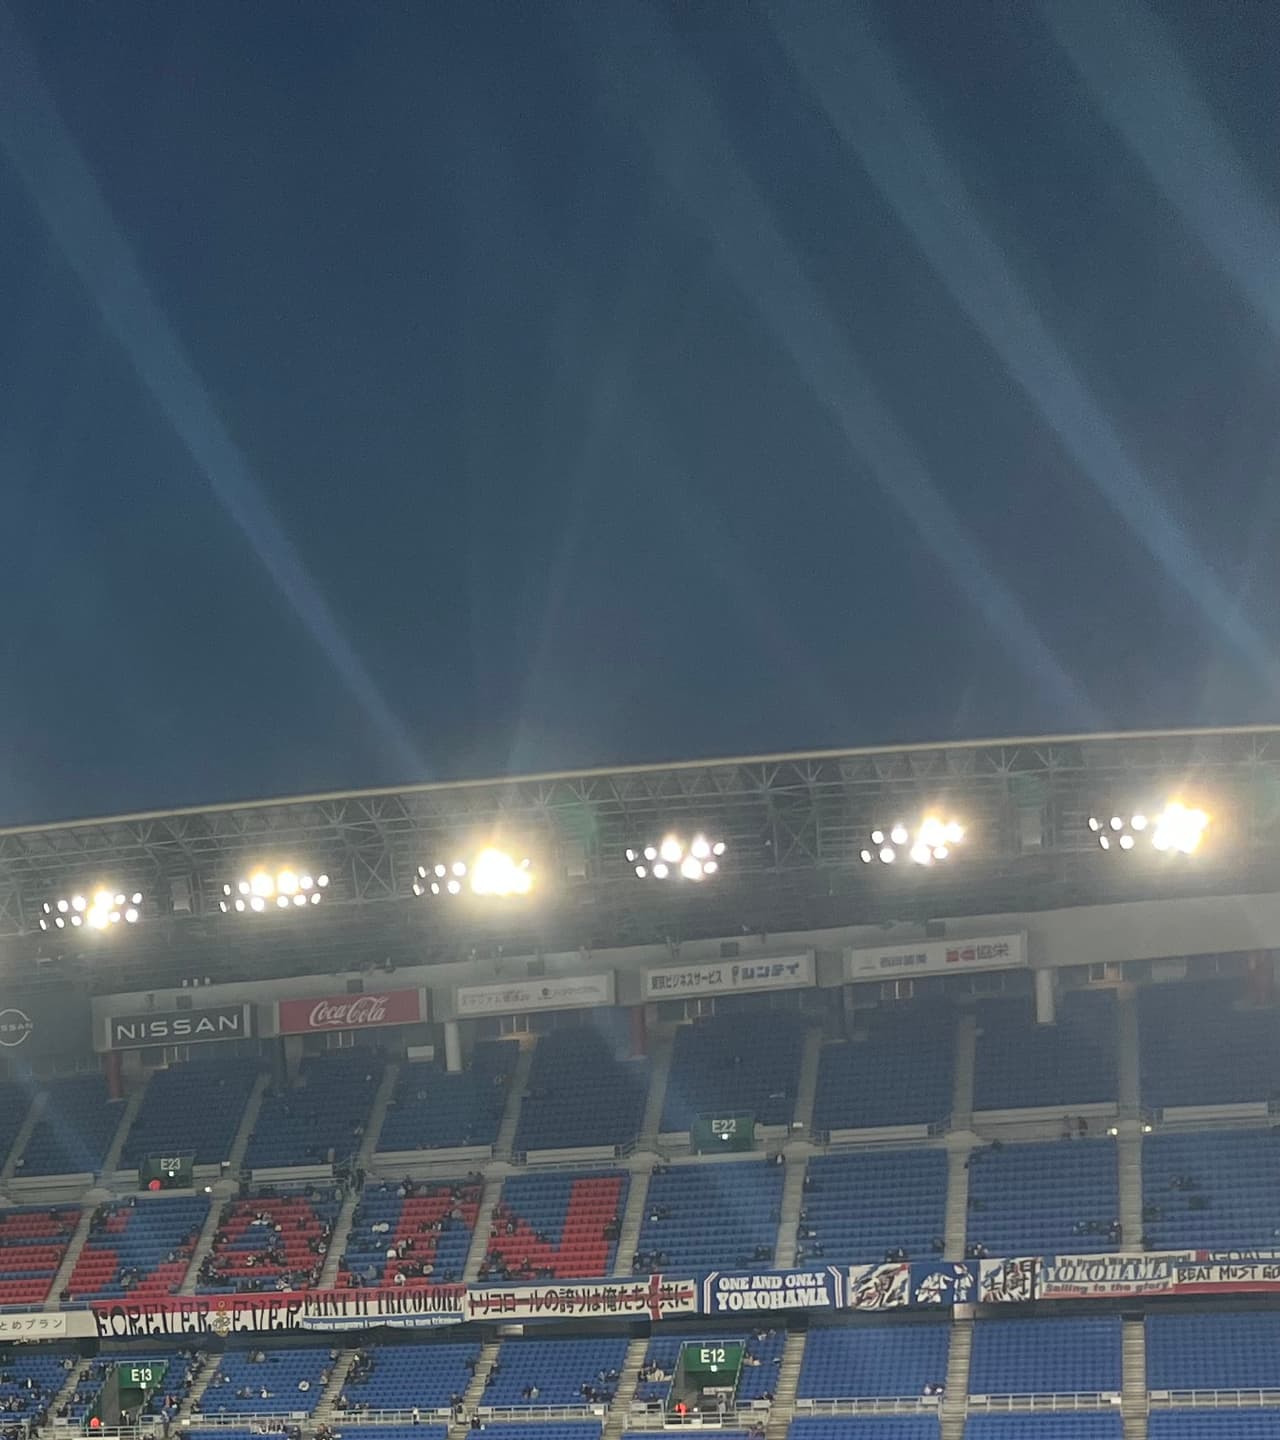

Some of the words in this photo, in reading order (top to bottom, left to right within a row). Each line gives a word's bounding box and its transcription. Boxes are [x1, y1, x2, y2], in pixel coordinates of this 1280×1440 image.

[117, 1015, 238, 1040] NISSAN
[712, 1119, 736, 1132] E22
[160, 1159, 181, 1171] E23
[1046, 1263, 1168, 1281] YOKOHAMA
[1177, 1266, 1213, 1283] BEAT
[1219, 1265, 1258, 1281] MUST
[719, 1276, 749, 1291] ONE
[751, 1275, 782, 1290] AND
[785, 1272, 826, 1288] ONLY
[304, 1292, 350, 1316] PAINT
[355, 1291, 371, 1315] IT
[716, 1287, 830, 1311] YOKOHAMA
[93, 1302, 211, 1336] FOREVER
[700, 1349, 725, 1363] E12
[131, 1369, 152, 1381] E13
